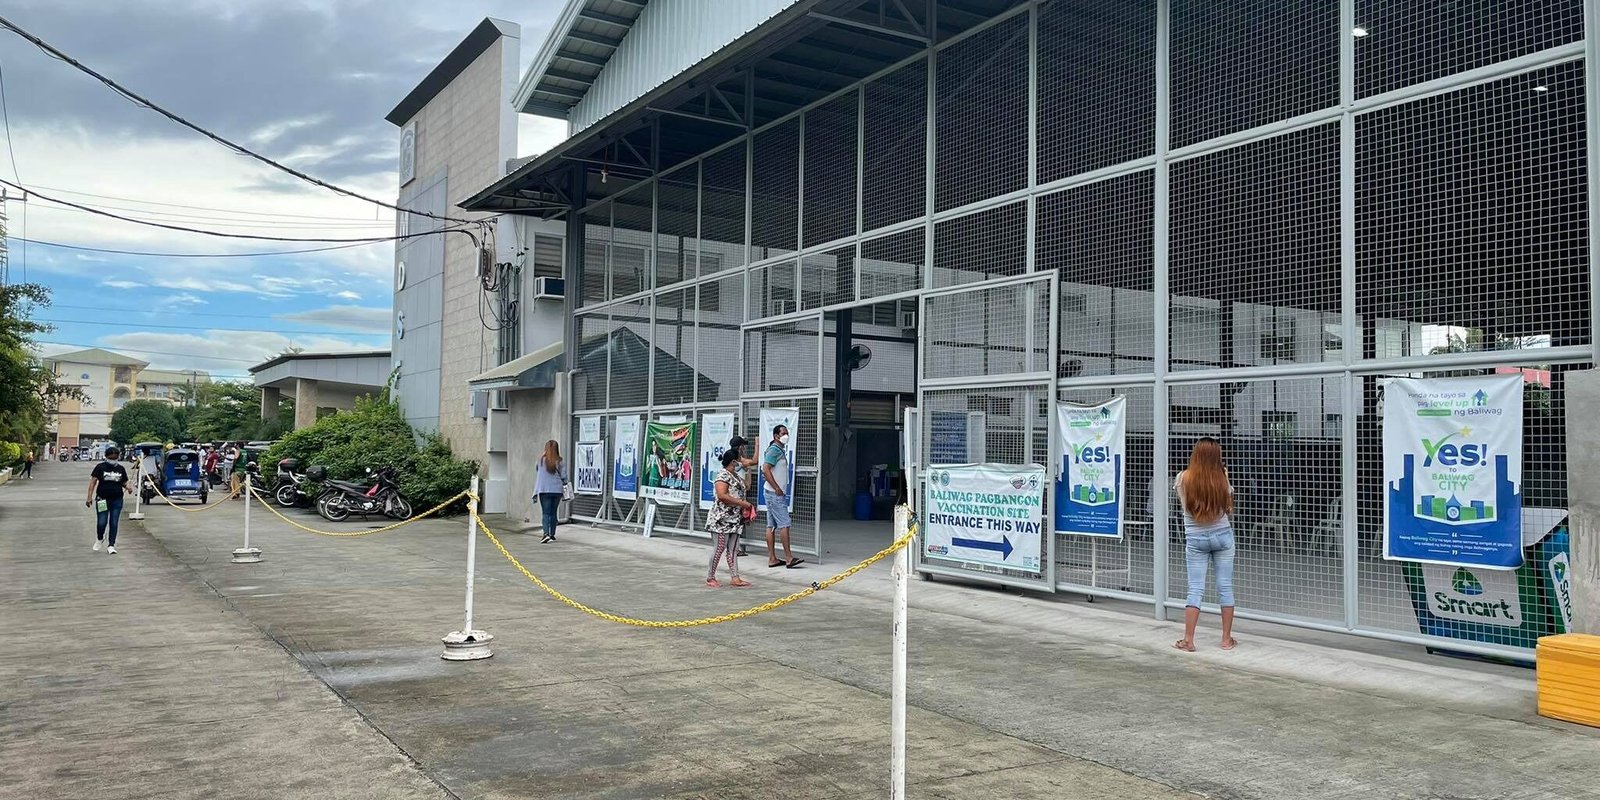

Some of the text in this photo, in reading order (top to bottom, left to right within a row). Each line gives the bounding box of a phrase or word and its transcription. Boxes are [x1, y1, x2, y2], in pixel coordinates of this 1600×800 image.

[1454, 409, 1465, 417] ng
[1467, 408, 1503, 416] Baliwag
[1456, 400, 1469, 409] up
[585, 449, 594, 467] NO
[1072, 441, 1111, 465] Yes!
[1421, 434, 1488, 467] Yes!
[578, 467, 601, 490] PARKING
[1431, 473, 1475, 482] BALIWAG
[1438, 481, 1468, 491] CITY
[929, 489, 1040, 507] BALIWAG PAGBANGON
[936, 502, 1030, 519] VACCINATION SITE
[929, 513, 1041, 534] ENTRANCE THIS WAY
[1434, 592, 1514, 620] Smart
